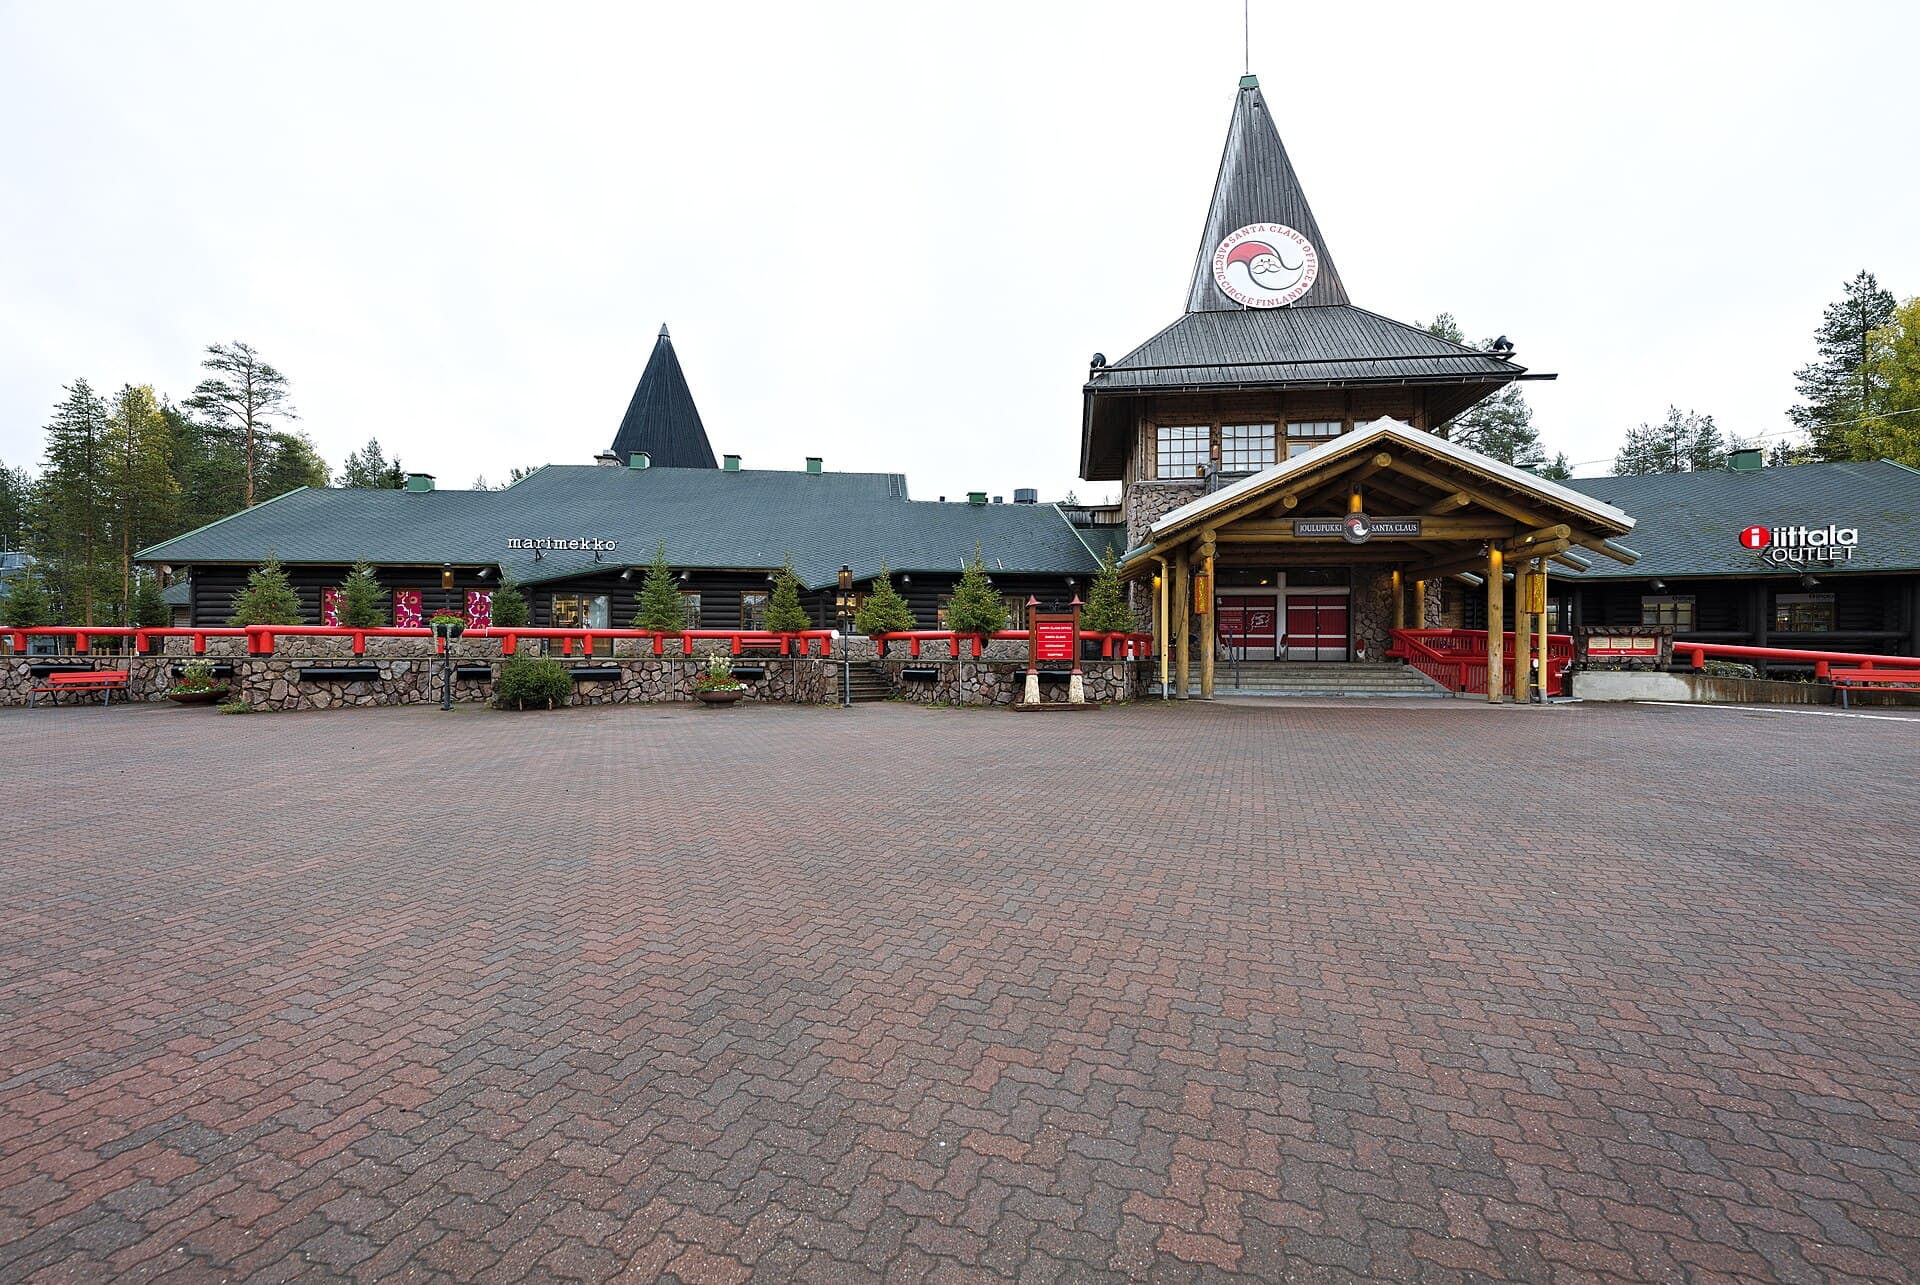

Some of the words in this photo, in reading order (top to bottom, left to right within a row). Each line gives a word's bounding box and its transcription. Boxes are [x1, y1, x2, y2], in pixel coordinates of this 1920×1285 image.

[1228, 225, 1265, 244] SANTA
[1269, 225, 1305, 245] CLAUS
[1302, 245, 1316, 282] OFFICE
[1215, 247, 1227, 281] ARCTIC
[1221, 280, 1255, 305] CIRCLE
[1255, 287, 1304, 307] FINLAND
[1371, 523, 1394, 532] SANTA
[1395, 523, 1417, 532] CLAUS
[1773, 524, 1859, 548] iittala
[507, 536, 617, 551] marimekko
[1772, 545, 1857, 562] OUTLET
